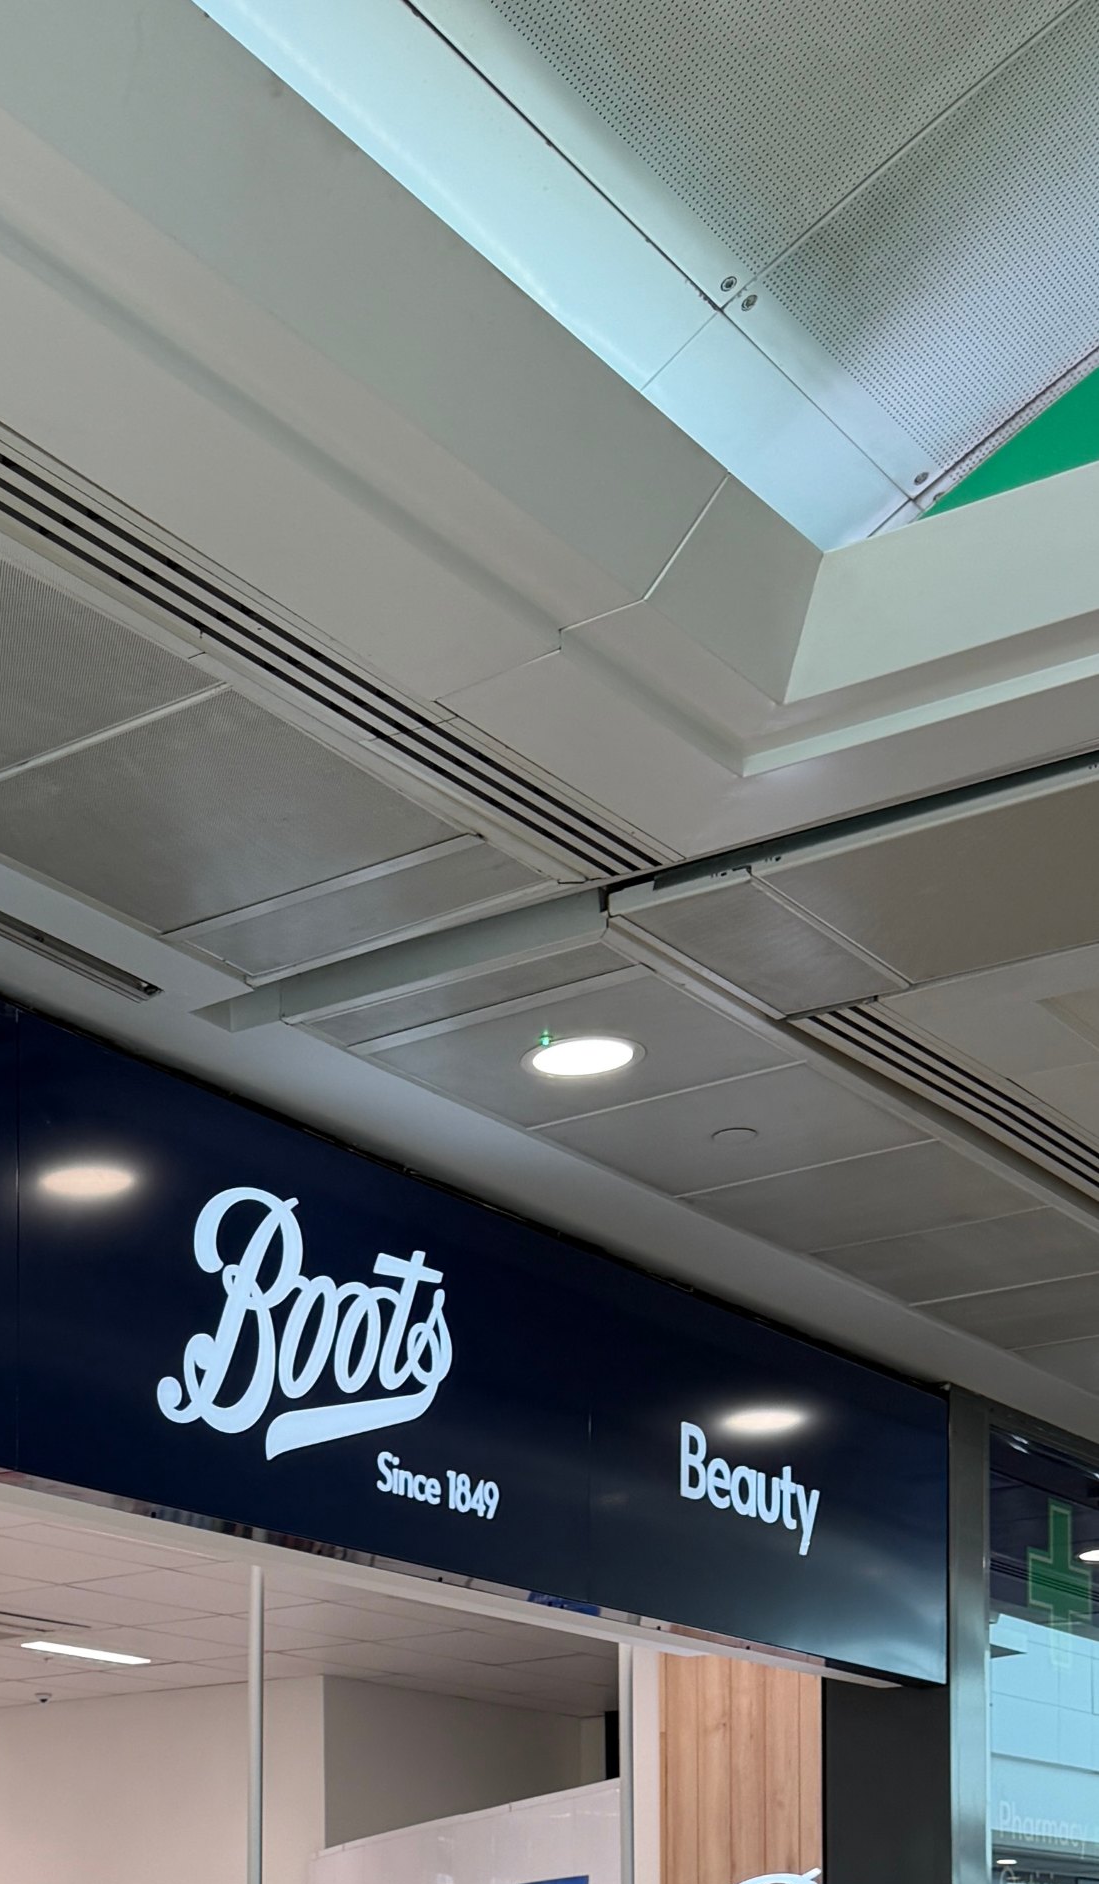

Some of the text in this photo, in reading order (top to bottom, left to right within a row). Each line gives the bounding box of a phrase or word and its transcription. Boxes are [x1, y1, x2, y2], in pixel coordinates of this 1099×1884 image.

[157, 1187, 453, 1461] Boots
[376, 1451, 500, 1520] Since 1849
[680, 1421, 821, 1556] Beauty
[998, 1800, 1087, 1859] Pharmacy
